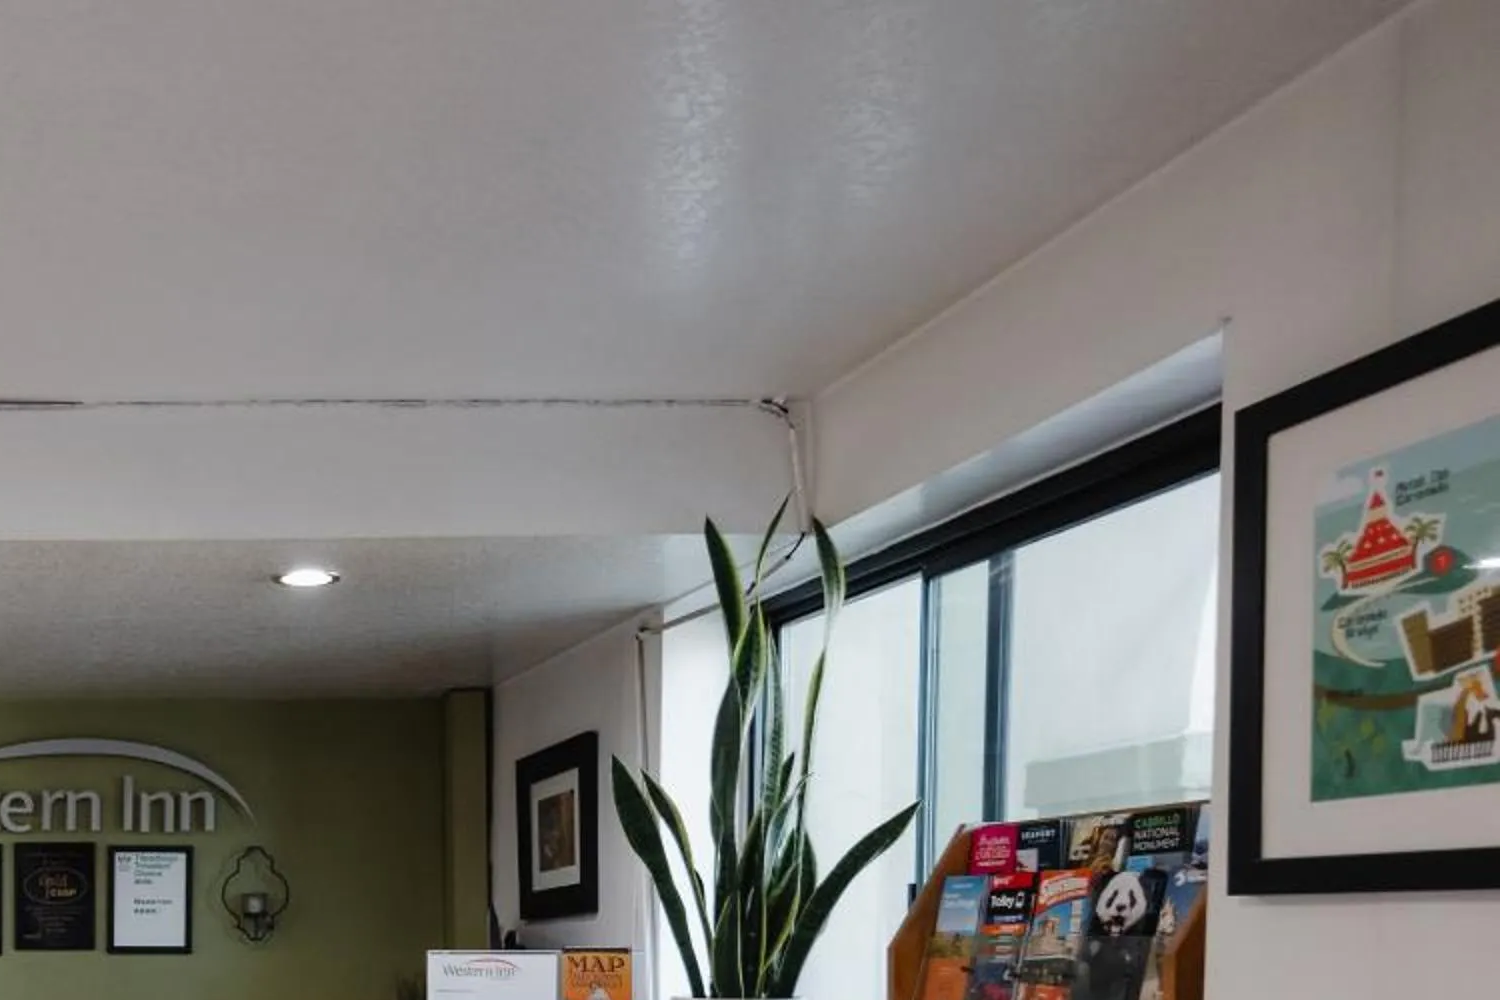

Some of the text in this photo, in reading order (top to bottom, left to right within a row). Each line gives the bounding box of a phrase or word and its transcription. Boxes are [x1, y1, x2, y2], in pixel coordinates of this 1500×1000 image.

[122, 775, 216, 833] Inn
[1133, 838, 1181, 851] MONUMENT
[442, 963, 515, 977] Western Inn
[567, 955, 625, 973] MAP
